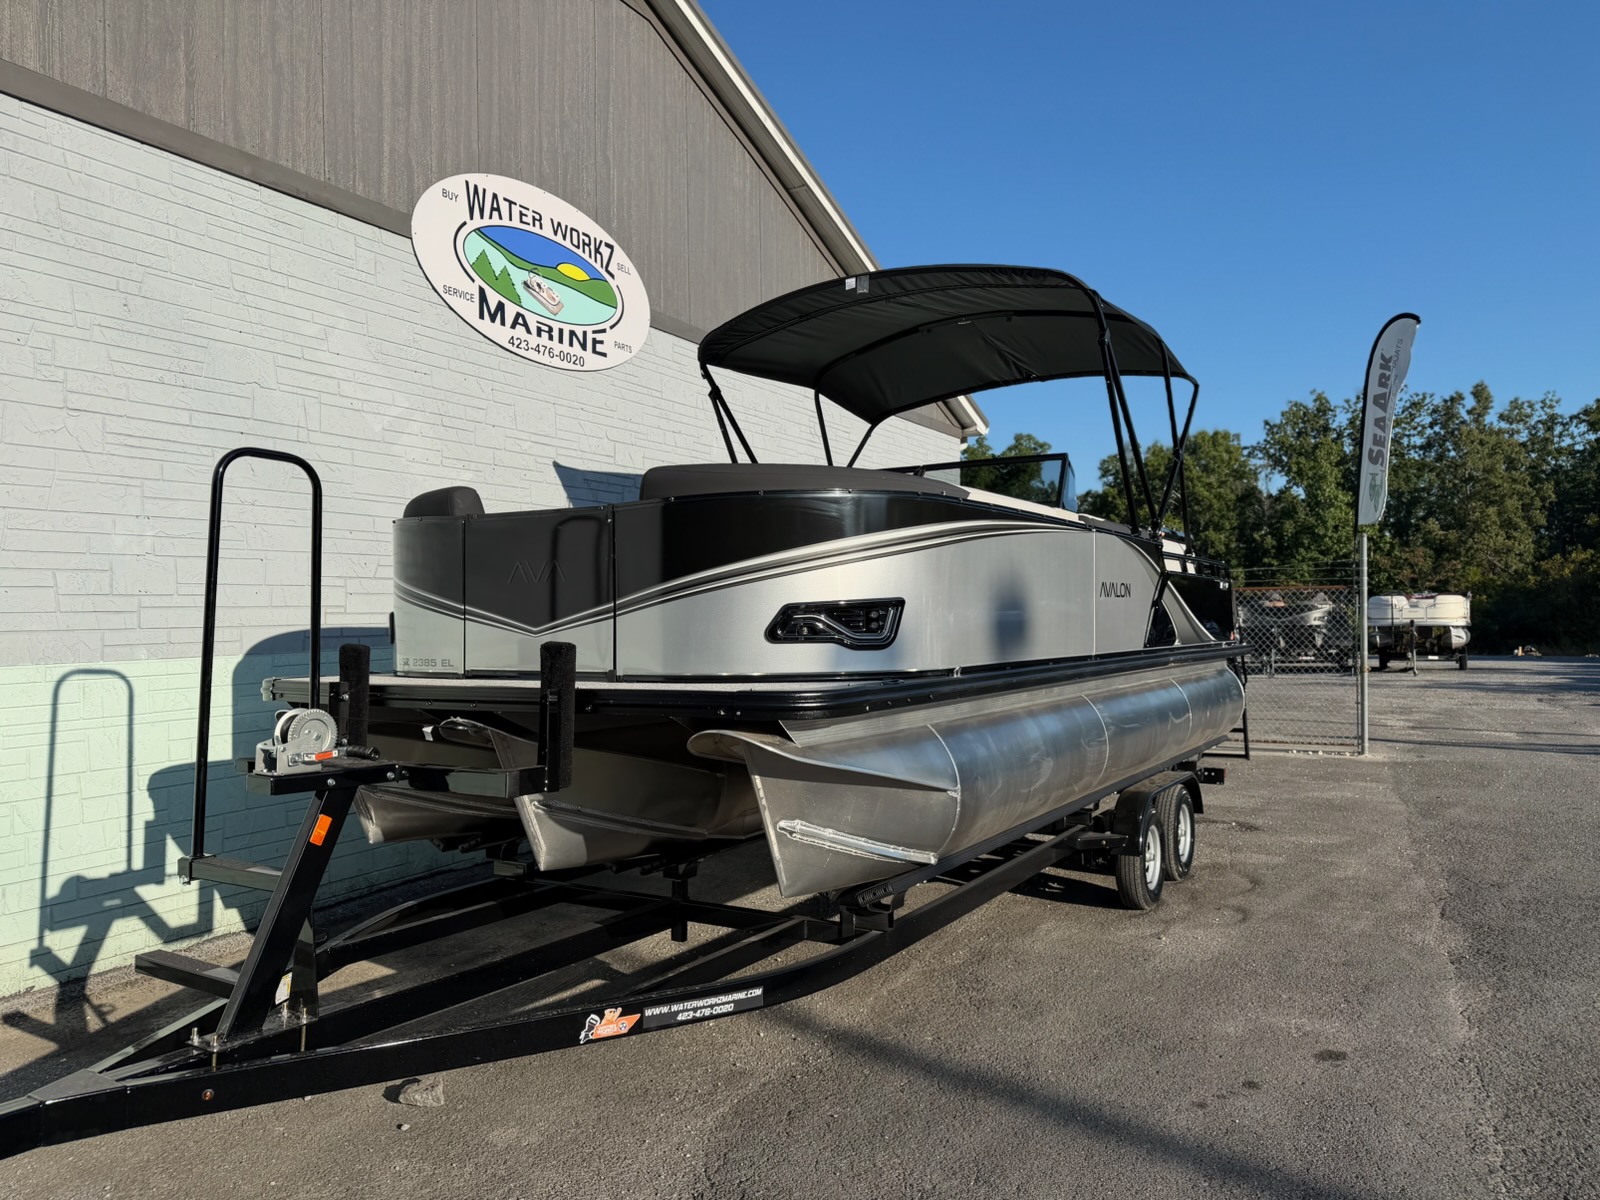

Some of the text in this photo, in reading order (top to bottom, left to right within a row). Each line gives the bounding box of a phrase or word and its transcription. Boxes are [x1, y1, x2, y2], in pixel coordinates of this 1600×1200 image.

[442, 188, 459, 202] BUY
[465, 180, 615, 280] WATER WORKZ
[616, 262, 632, 276] SELL
[442, 284, 476, 303] SERVICE
[478, 285, 608, 359] MARINE
[507, 335, 586, 368] 423-476-0020
[614, 341, 632, 353] PARTS
[1099, 581, 1132, 598] AVALON
[412, 658, 455, 668] 2385 EL
[645, 988, 762, 1017] WWW.WATERWORKZMARINE.COM
[677, 1003, 734, 1020] 423-476-0020
